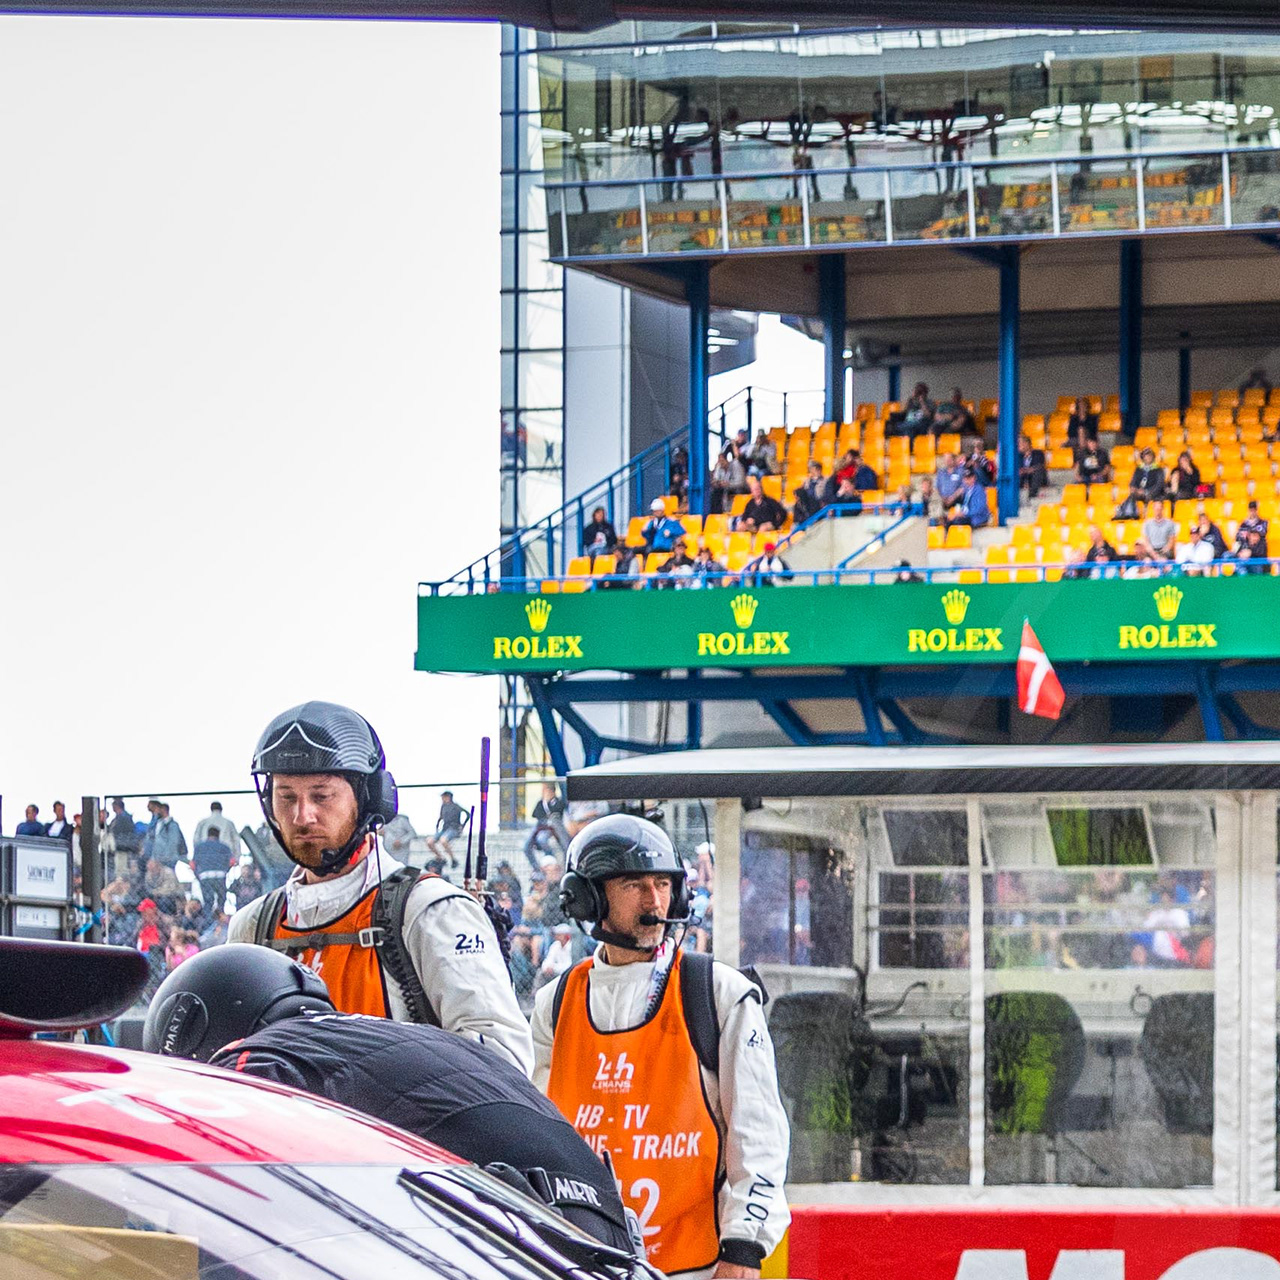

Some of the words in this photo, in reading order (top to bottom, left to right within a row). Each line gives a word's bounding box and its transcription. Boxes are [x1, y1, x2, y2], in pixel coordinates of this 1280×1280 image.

[493, 635, 583, 659] ROLEX
[698, 631, 790, 656] ROLEX
[908, 627, 1003, 653] ROLEX
[1119, 623, 1217, 650] ROLEX
[164, 1004, 188, 1054] MARTY
[574, 1105, 604, 1129] HB
[624, 1104, 650, 1129] TV
[632, 1132, 702, 1160] TRACK
[749, 1173, 775, 1201] TV
[617, 1178, 662, 1237] 2
